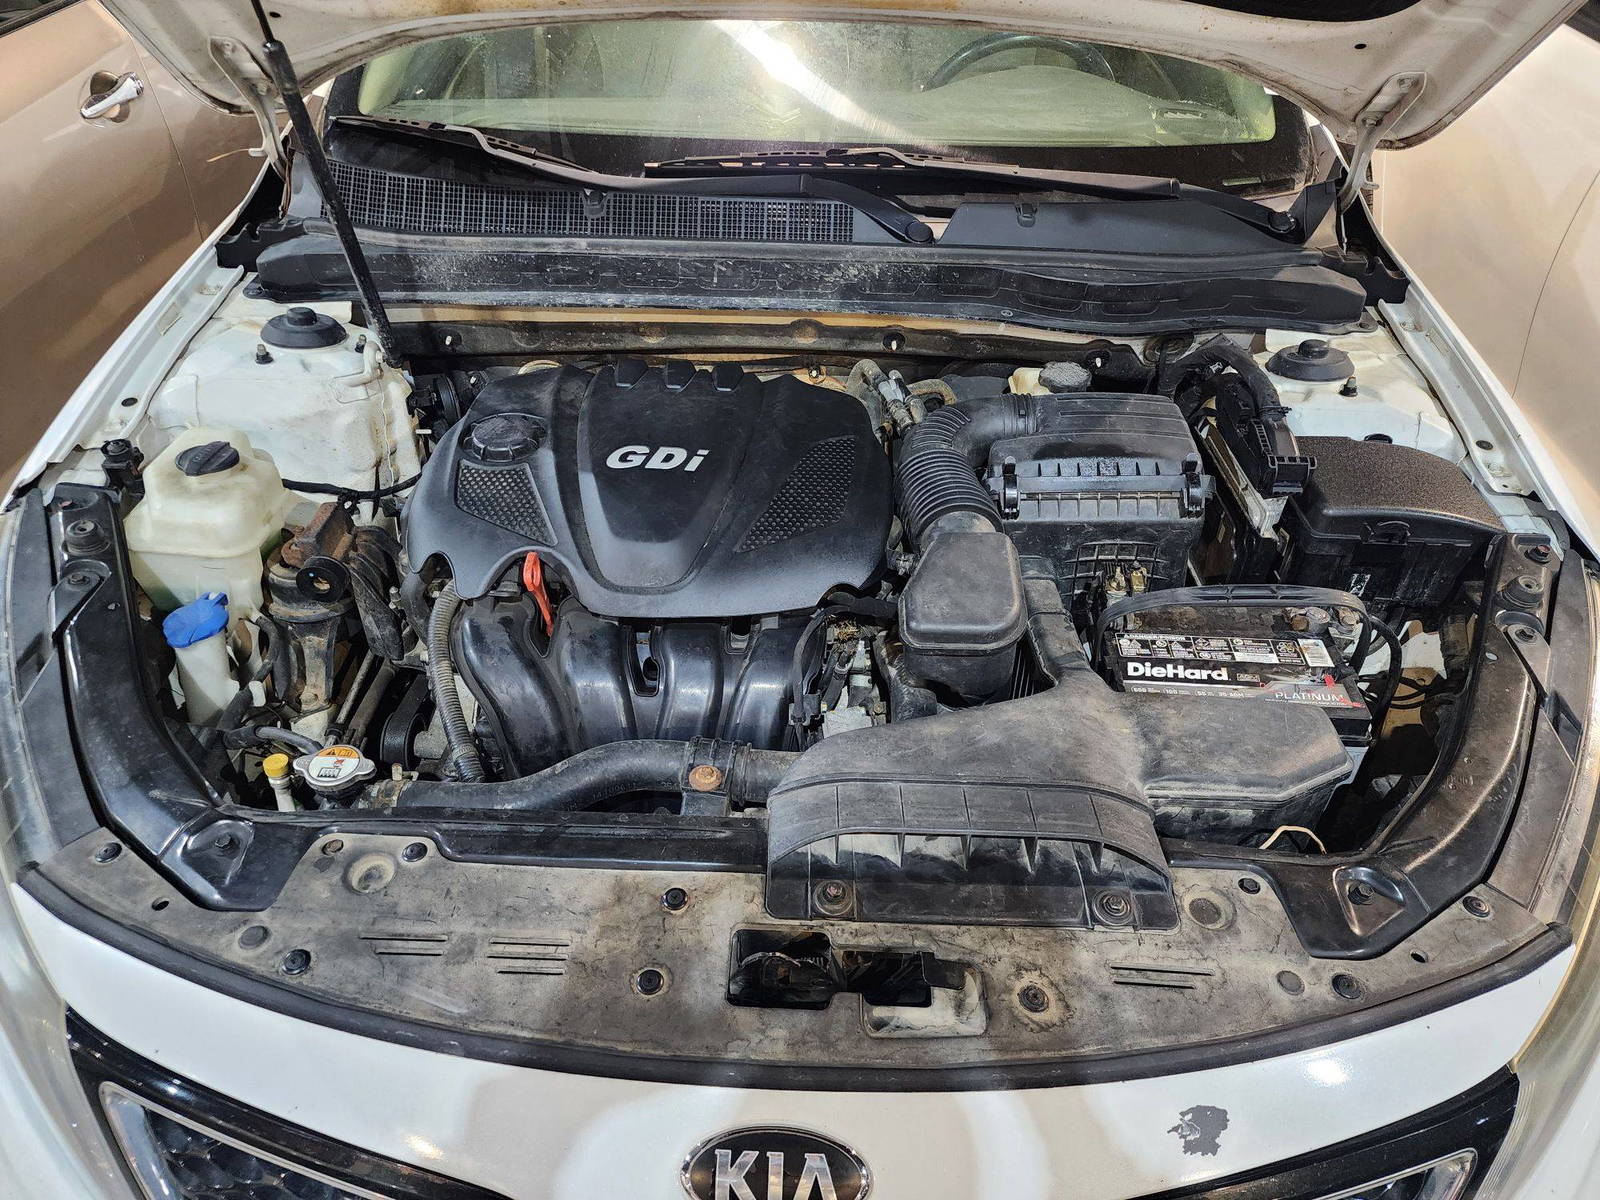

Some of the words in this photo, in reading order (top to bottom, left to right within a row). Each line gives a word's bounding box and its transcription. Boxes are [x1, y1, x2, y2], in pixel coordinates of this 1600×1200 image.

[606, 445, 710, 472] GDi
[1127, 661, 1229, 681] DieHard
[1275, 691, 1344, 702] PLATINUM
[714, 1149, 838, 1200] KIA
